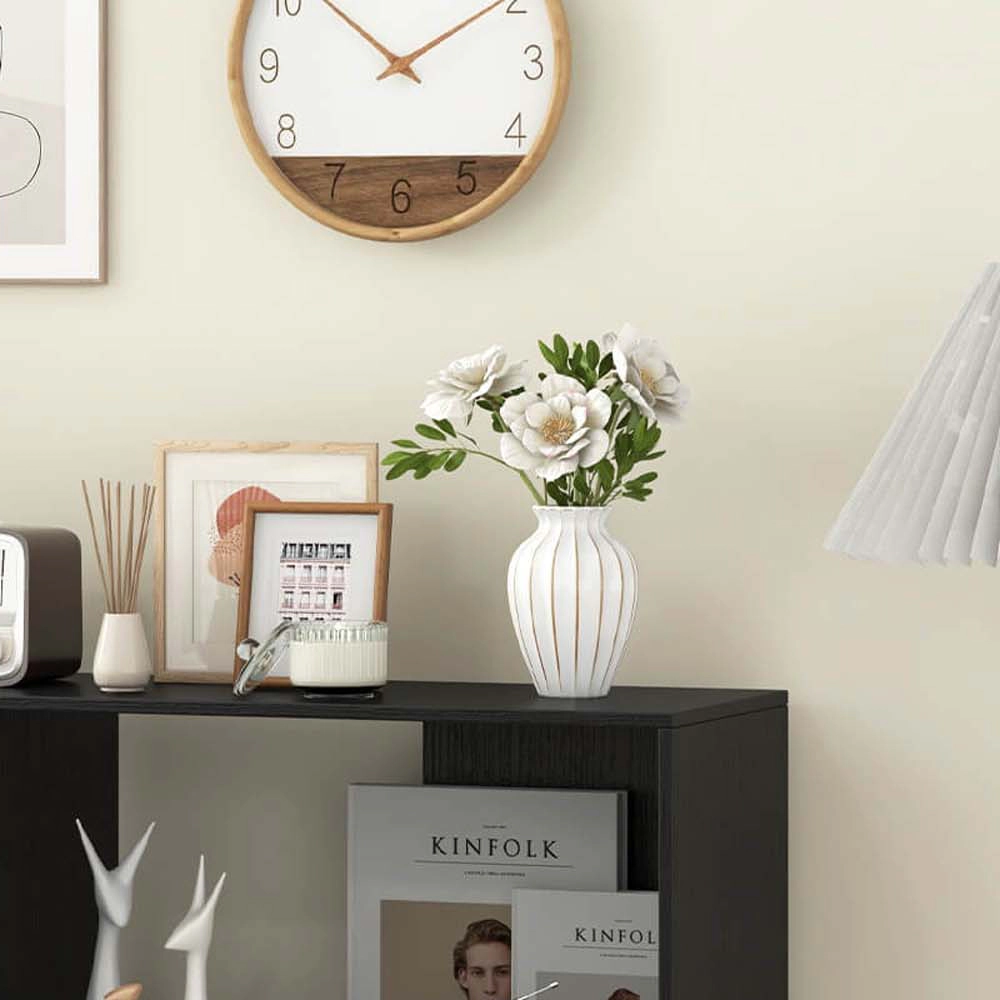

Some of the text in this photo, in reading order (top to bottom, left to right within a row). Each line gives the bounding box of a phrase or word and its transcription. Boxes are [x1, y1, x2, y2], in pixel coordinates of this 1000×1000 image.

[259, 48, 279, 84] 9
[523, 44, 544, 81] 3
[277, 113, 296, 149] 8
[504, 112, 527, 148] 4
[324, 163, 346, 199] 7
[456, 160, 477, 196] 5
[391, 179, 412, 215] 6
[431, 836, 560, 860] KINFOLK
[574, 927, 657, 945] KINFOL
